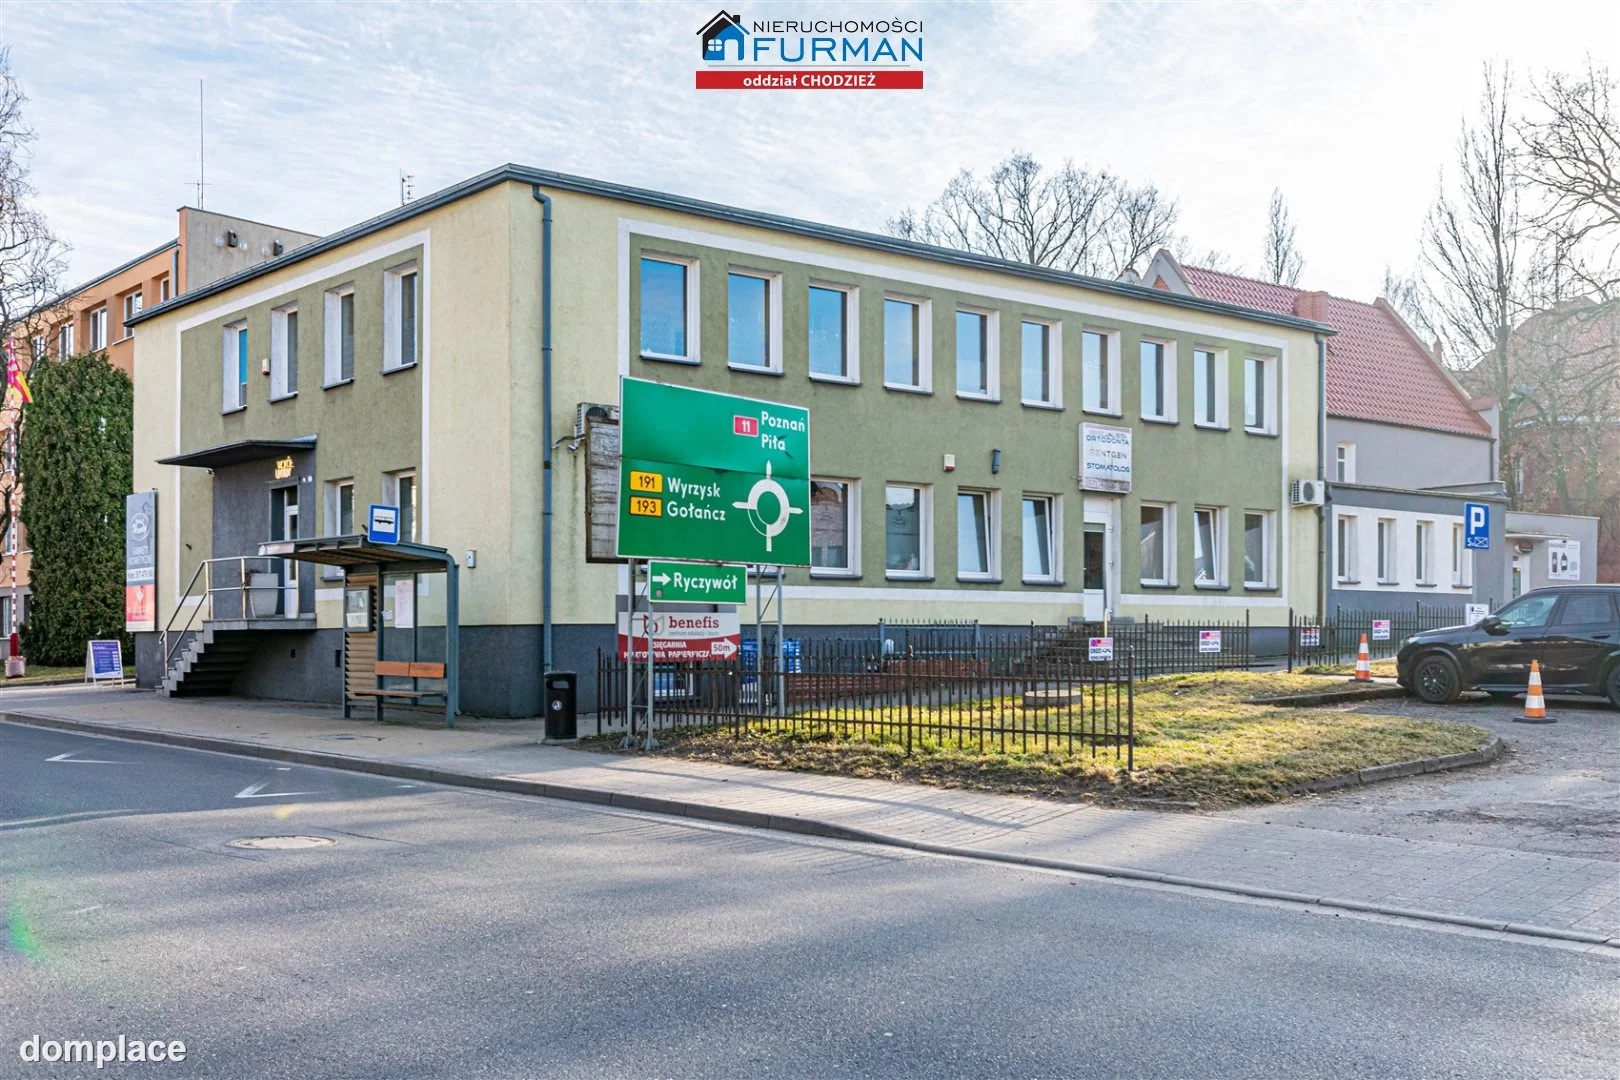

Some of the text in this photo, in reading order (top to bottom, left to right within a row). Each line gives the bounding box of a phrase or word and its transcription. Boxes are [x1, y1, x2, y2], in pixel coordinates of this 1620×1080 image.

[742, 410, 805, 433] 11 Poznań
[761, 433, 786, 451] Piła
[1086, 435, 1129, 445] ORTODONTA
[1086, 463, 1130, 472] STOMATOLOG
[638, 475, 721, 501] 191 Wyrzysk
[637, 500, 726, 521] 193 Gołańcz
[1470, 506, 1486, 535] P
[673, 572, 738, 593] Ryczywół
[669, 615, 720, 629] benefis
[653, 641, 687, 650] SIĘGARNIA
[713, 644, 731, 652] 50m
